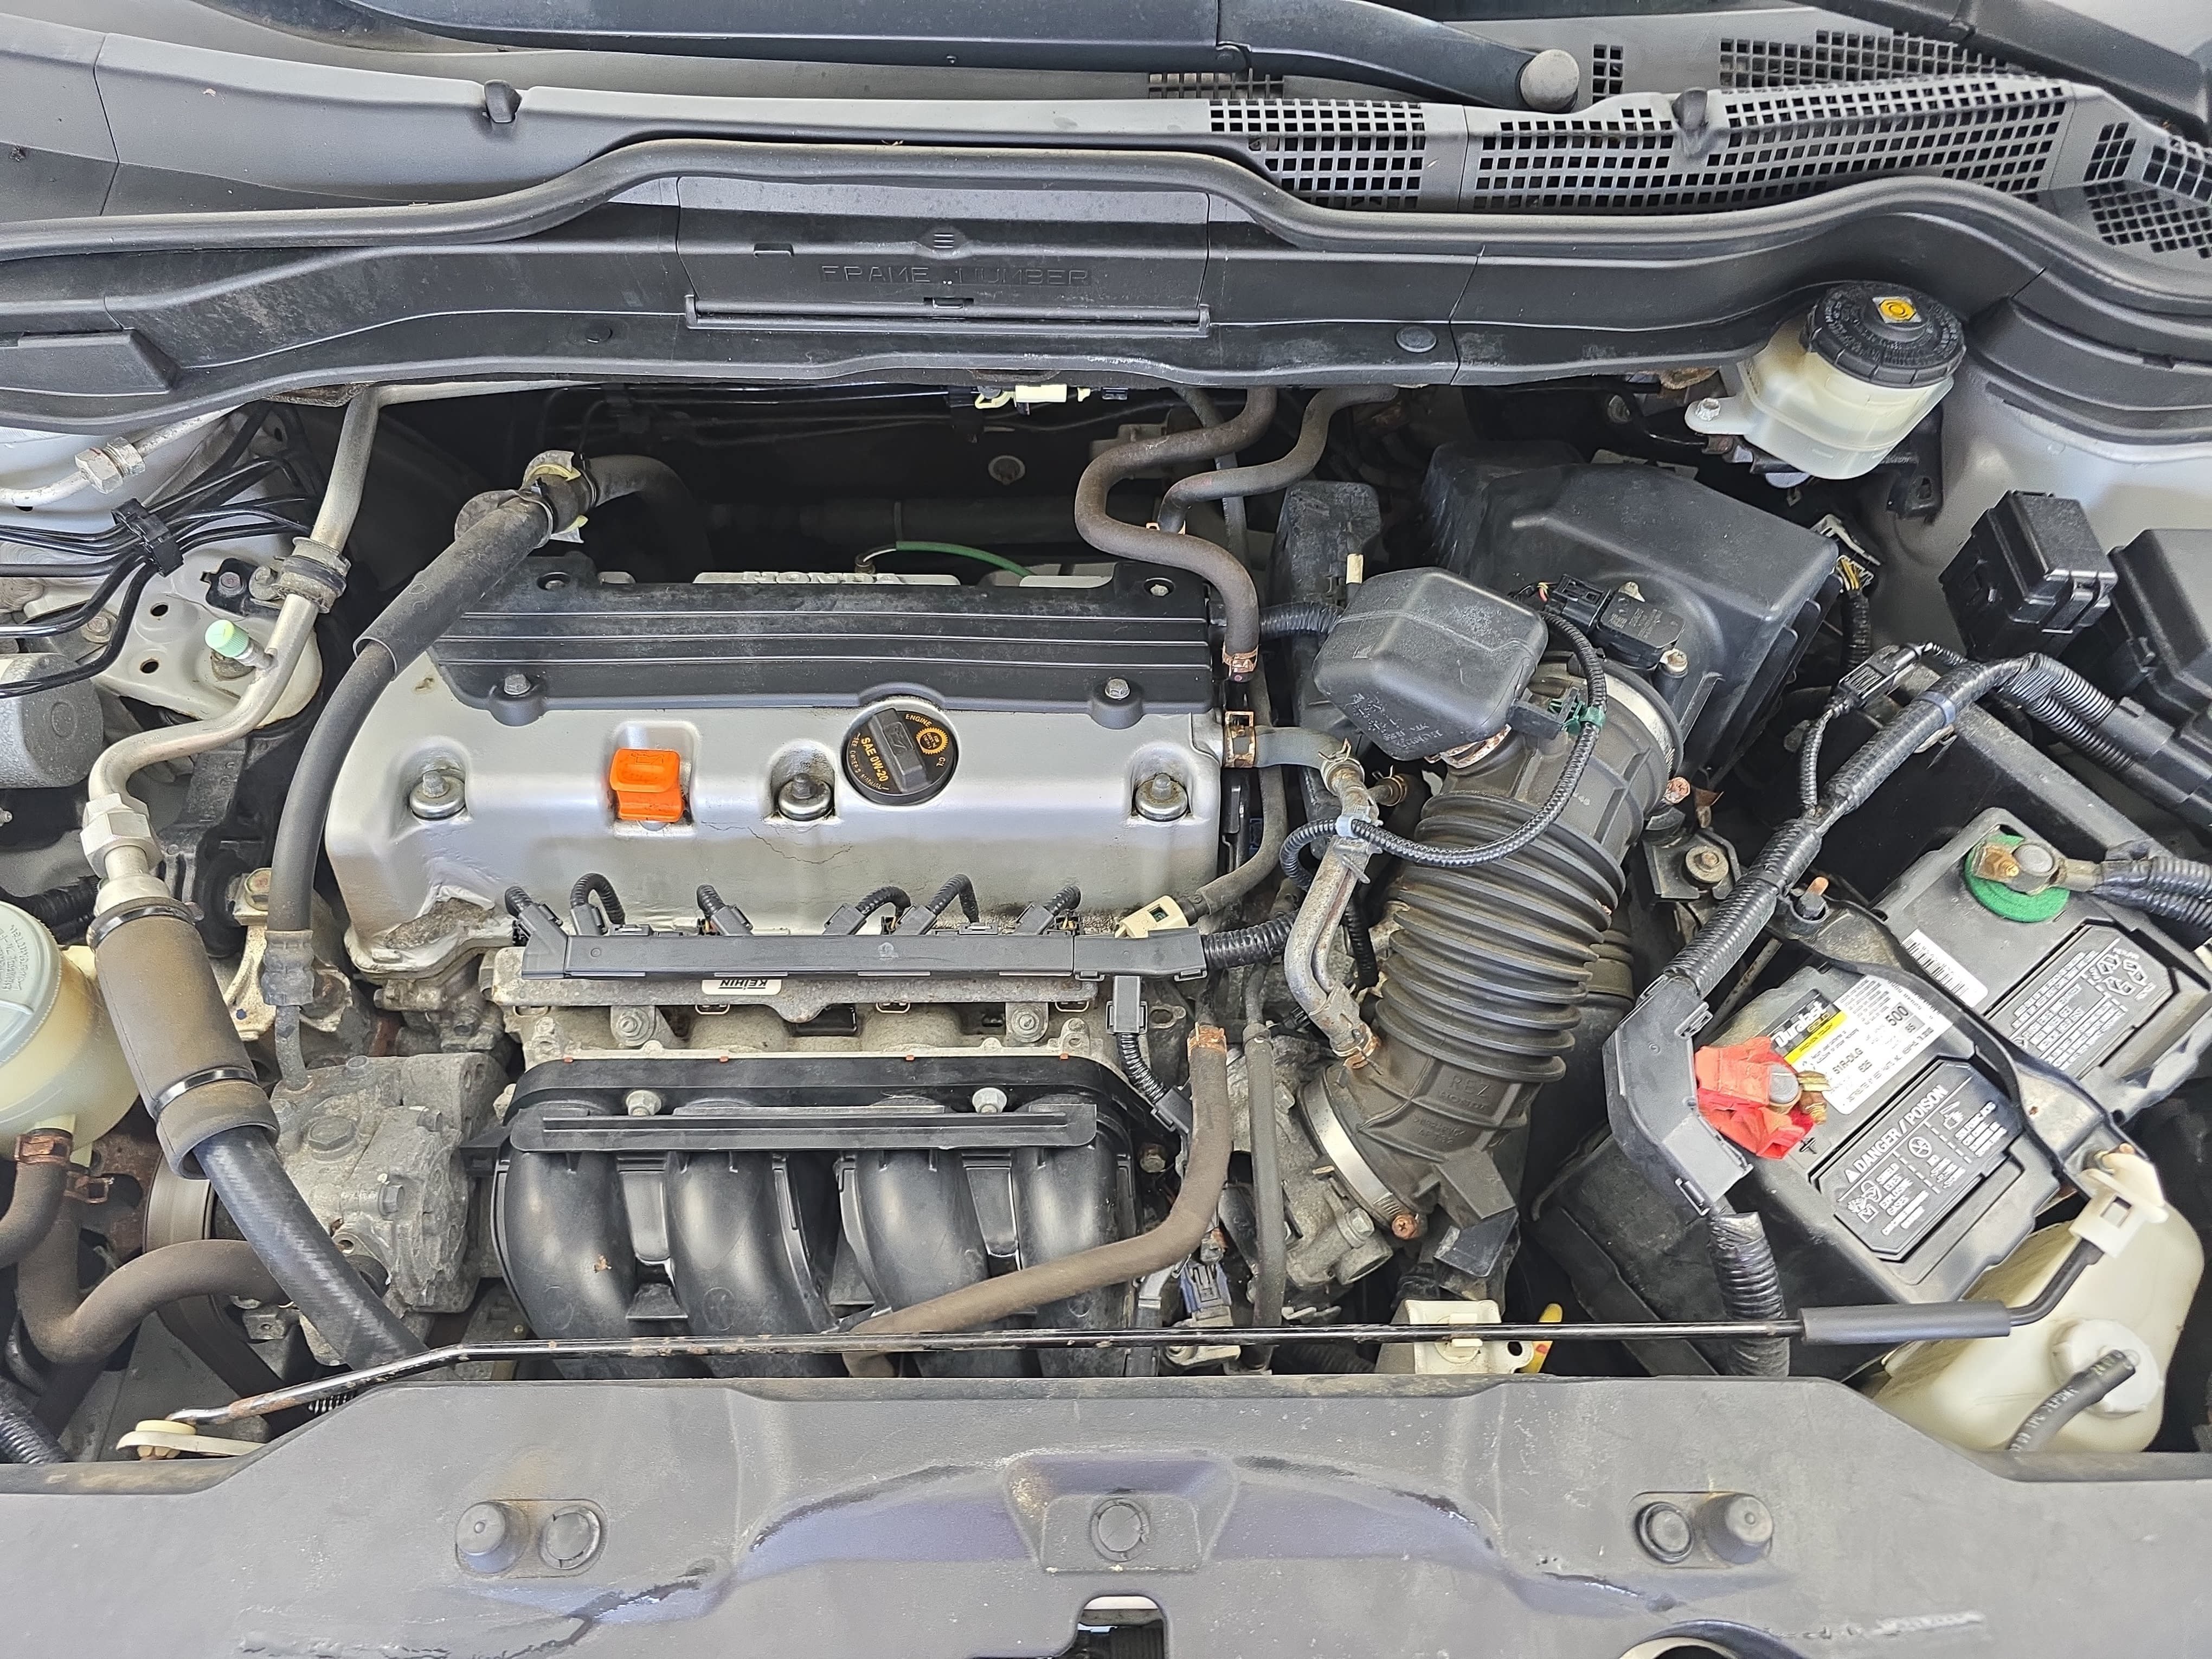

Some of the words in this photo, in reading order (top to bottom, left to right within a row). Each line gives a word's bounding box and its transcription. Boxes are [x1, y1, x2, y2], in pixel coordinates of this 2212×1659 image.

[821, 265, 930, 282] FRAME
[905, 713, 933, 728] ENGINE
[861, 737, 877, 757] SAE
[719, 979, 768, 988] KEIHIN
[1772, 1000, 1827, 1049] Duralast
[1885, 1004, 1909, 1028] 500
